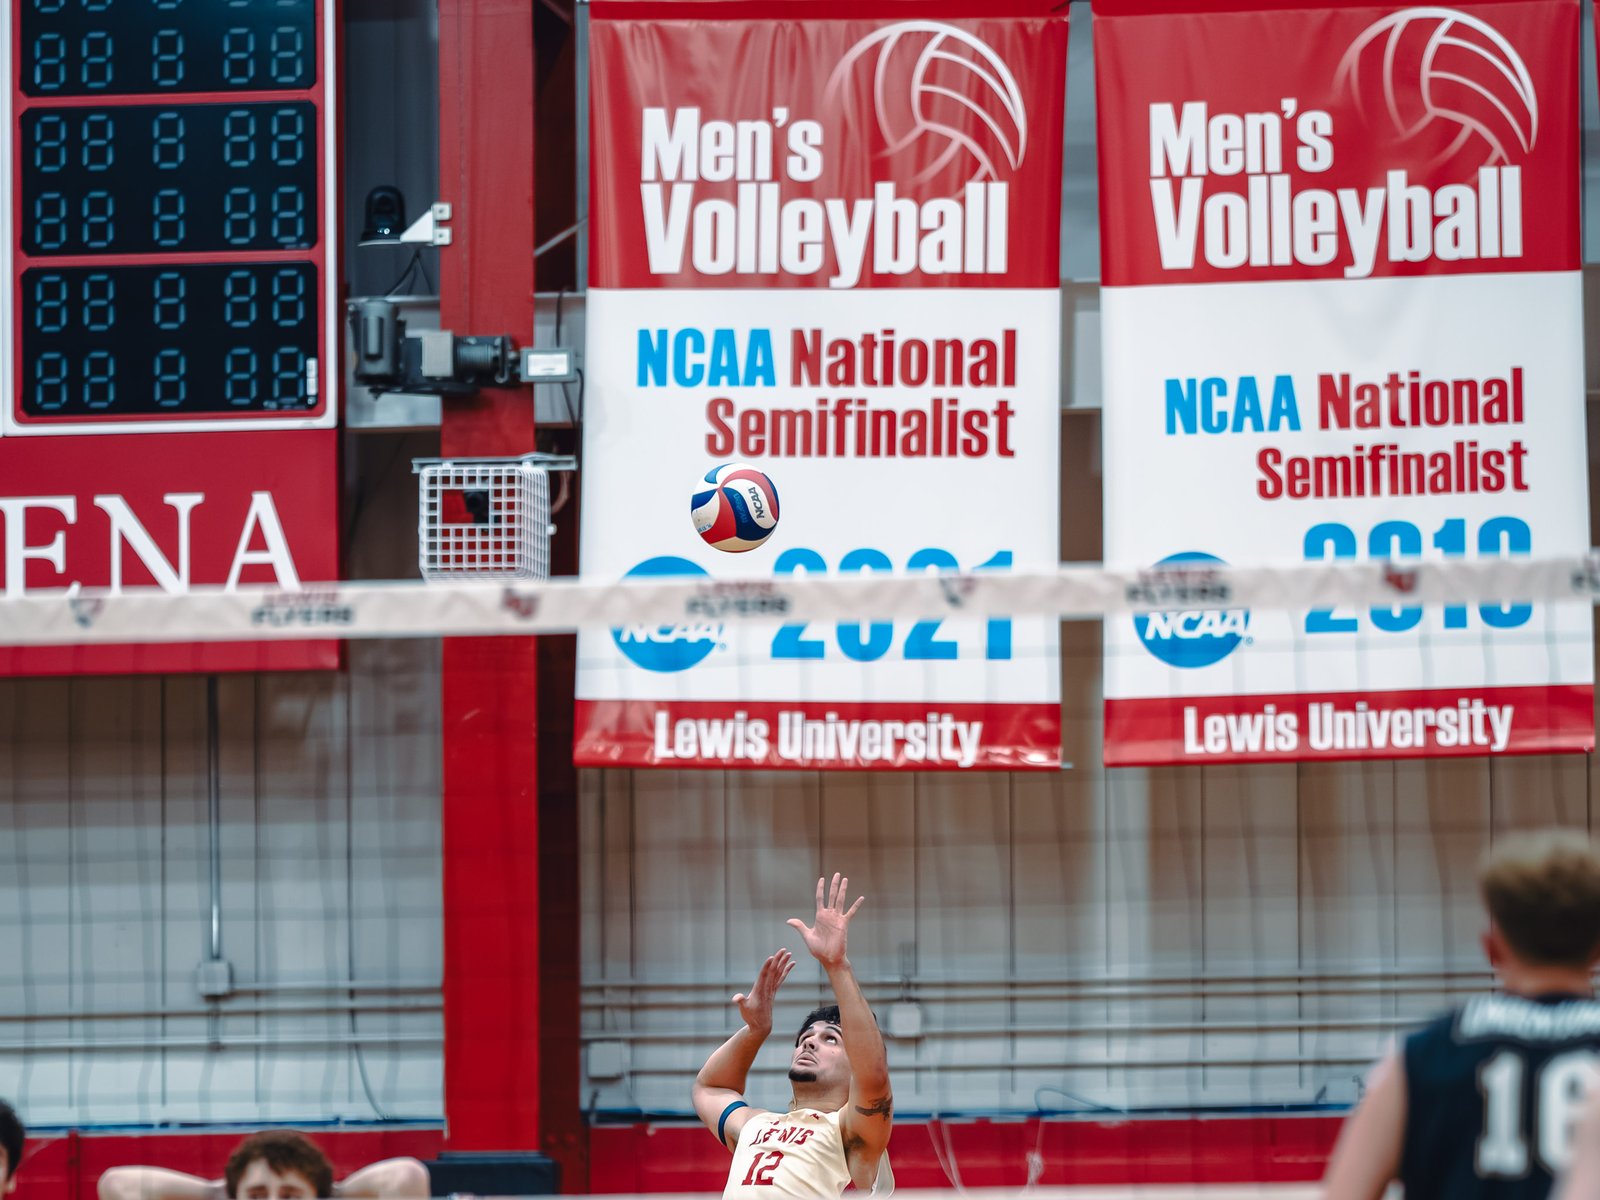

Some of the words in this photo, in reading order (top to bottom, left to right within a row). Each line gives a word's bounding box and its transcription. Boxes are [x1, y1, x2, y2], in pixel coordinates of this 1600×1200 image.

[641, 107, 823, 182] Men's
[1149, 98, 1334, 177] Men's
[640, 181, 1009, 288] Volleyball
[1150, 165, 1523, 279] Volleyball
[637, 327, 776, 388] NCAA
[790, 328, 1017, 388] National
[705, 397, 1016, 459] Semifinalist
[1164, 374, 1302, 435] NCAA
[1317, 366, 1524, 431] National
[1256, 440, 1530, 501] Semifinalist
[748, 486, 765, 519] NCAA
[0, 490, 303, 597] ENA
[770, 547, 1014, 662] 2021
[1144, 608, 1250, 641] NCAA
[654, 710, 769, 760] Lewis
[778, 711, 984, 768] University
[1184, 704, 1298, 754] Lewis
[1308, 698, 1514, 752] University
[742, 1150, 784, 1186] 12
